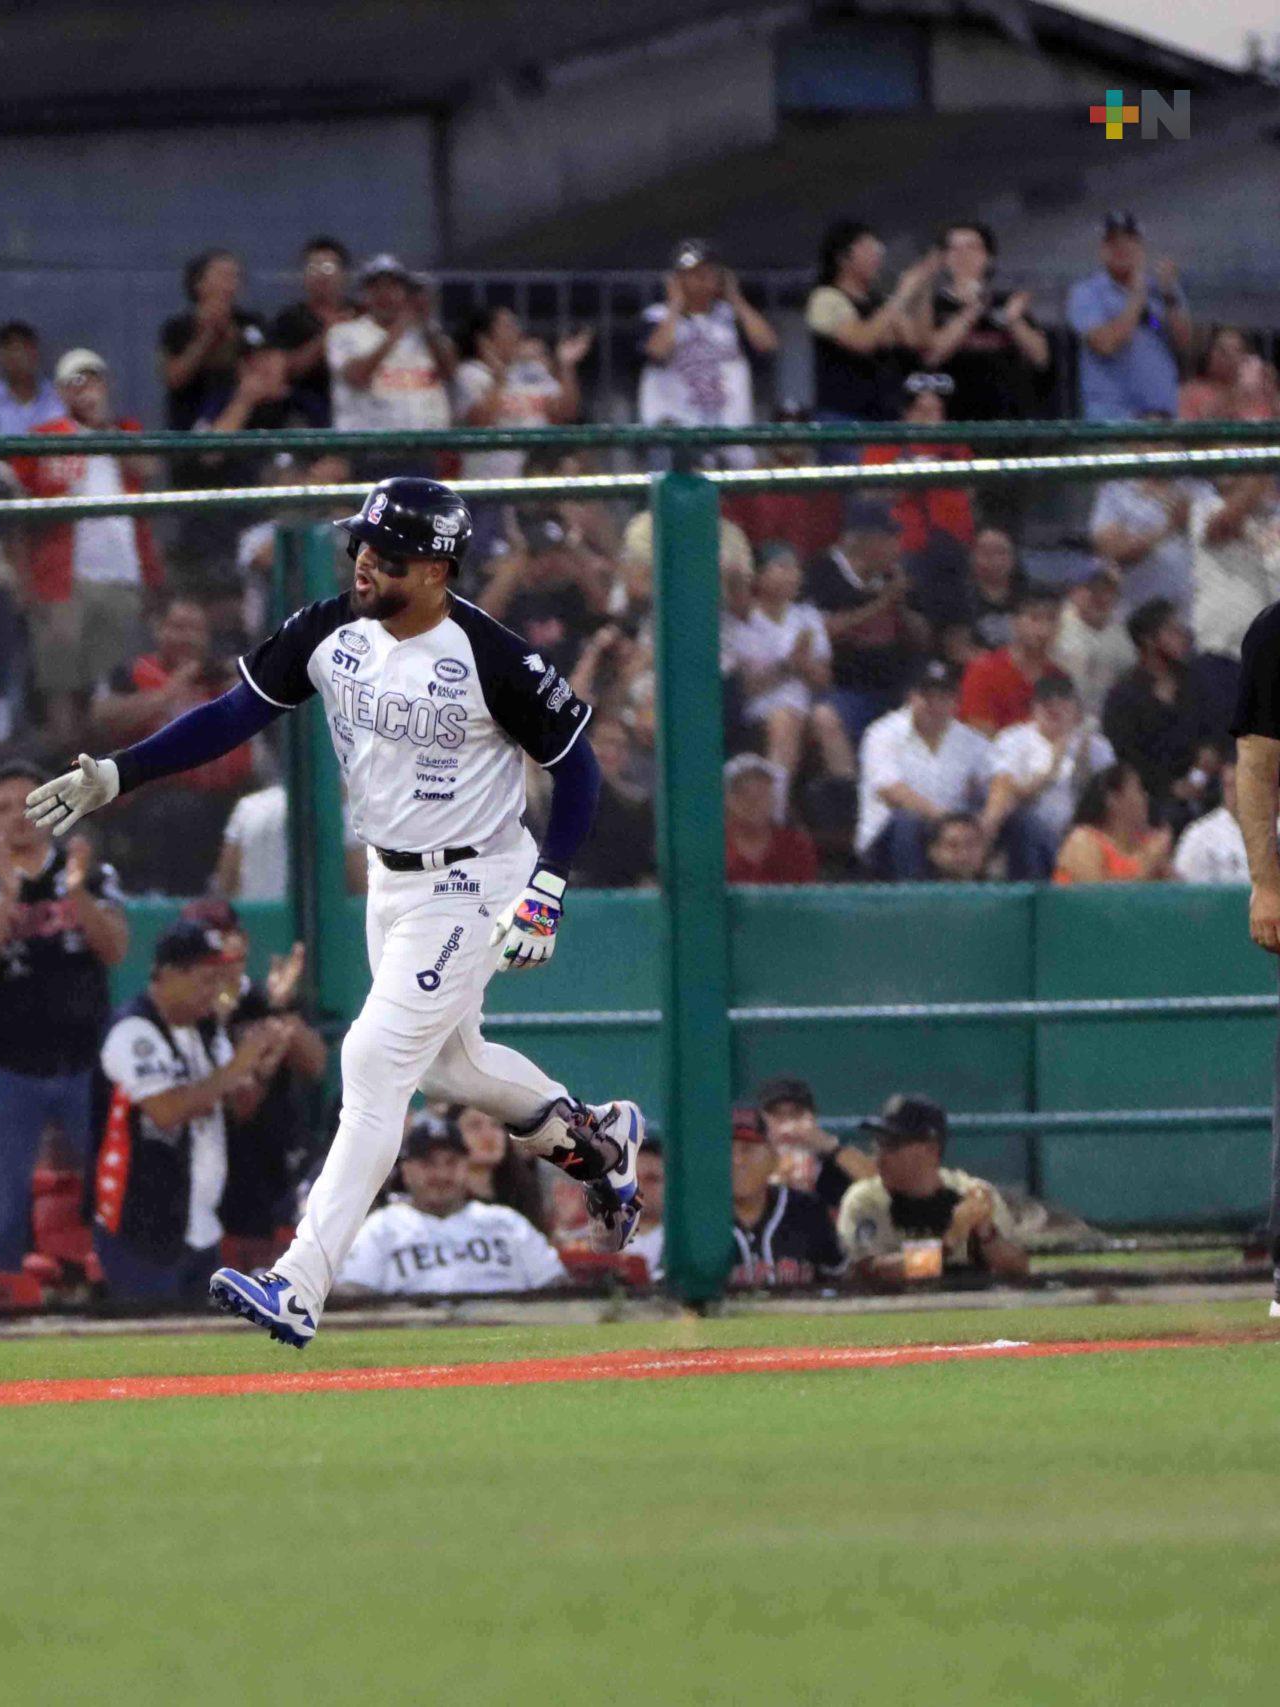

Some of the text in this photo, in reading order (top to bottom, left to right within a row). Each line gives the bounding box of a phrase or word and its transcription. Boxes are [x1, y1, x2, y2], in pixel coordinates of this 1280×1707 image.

[432, 537, 456, 552] STI
[332, 649, 360, 674] STI
[332, 671, 467, 749] TECOS
[434, 925, 465, 972] exelgas
